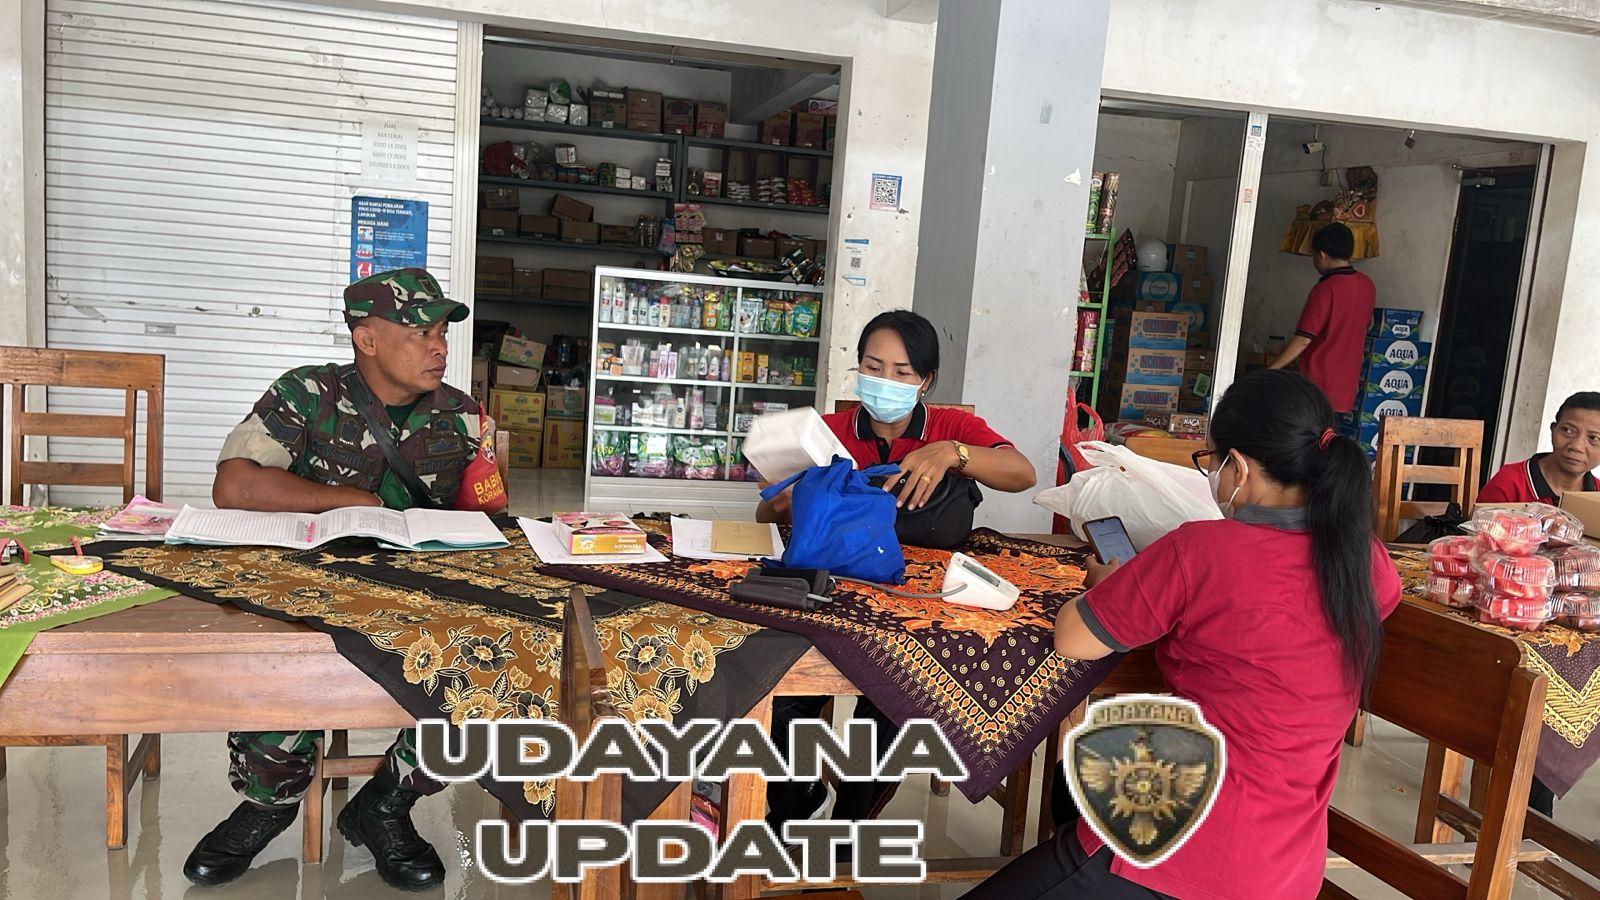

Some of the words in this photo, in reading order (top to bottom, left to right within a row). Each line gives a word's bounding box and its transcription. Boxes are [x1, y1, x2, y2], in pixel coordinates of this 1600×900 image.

[1389, 348, 1414, 361] AQUA
[1384, 378, 1409, 390] AQUA
[1183, 417, 1200, 427] NAGA
